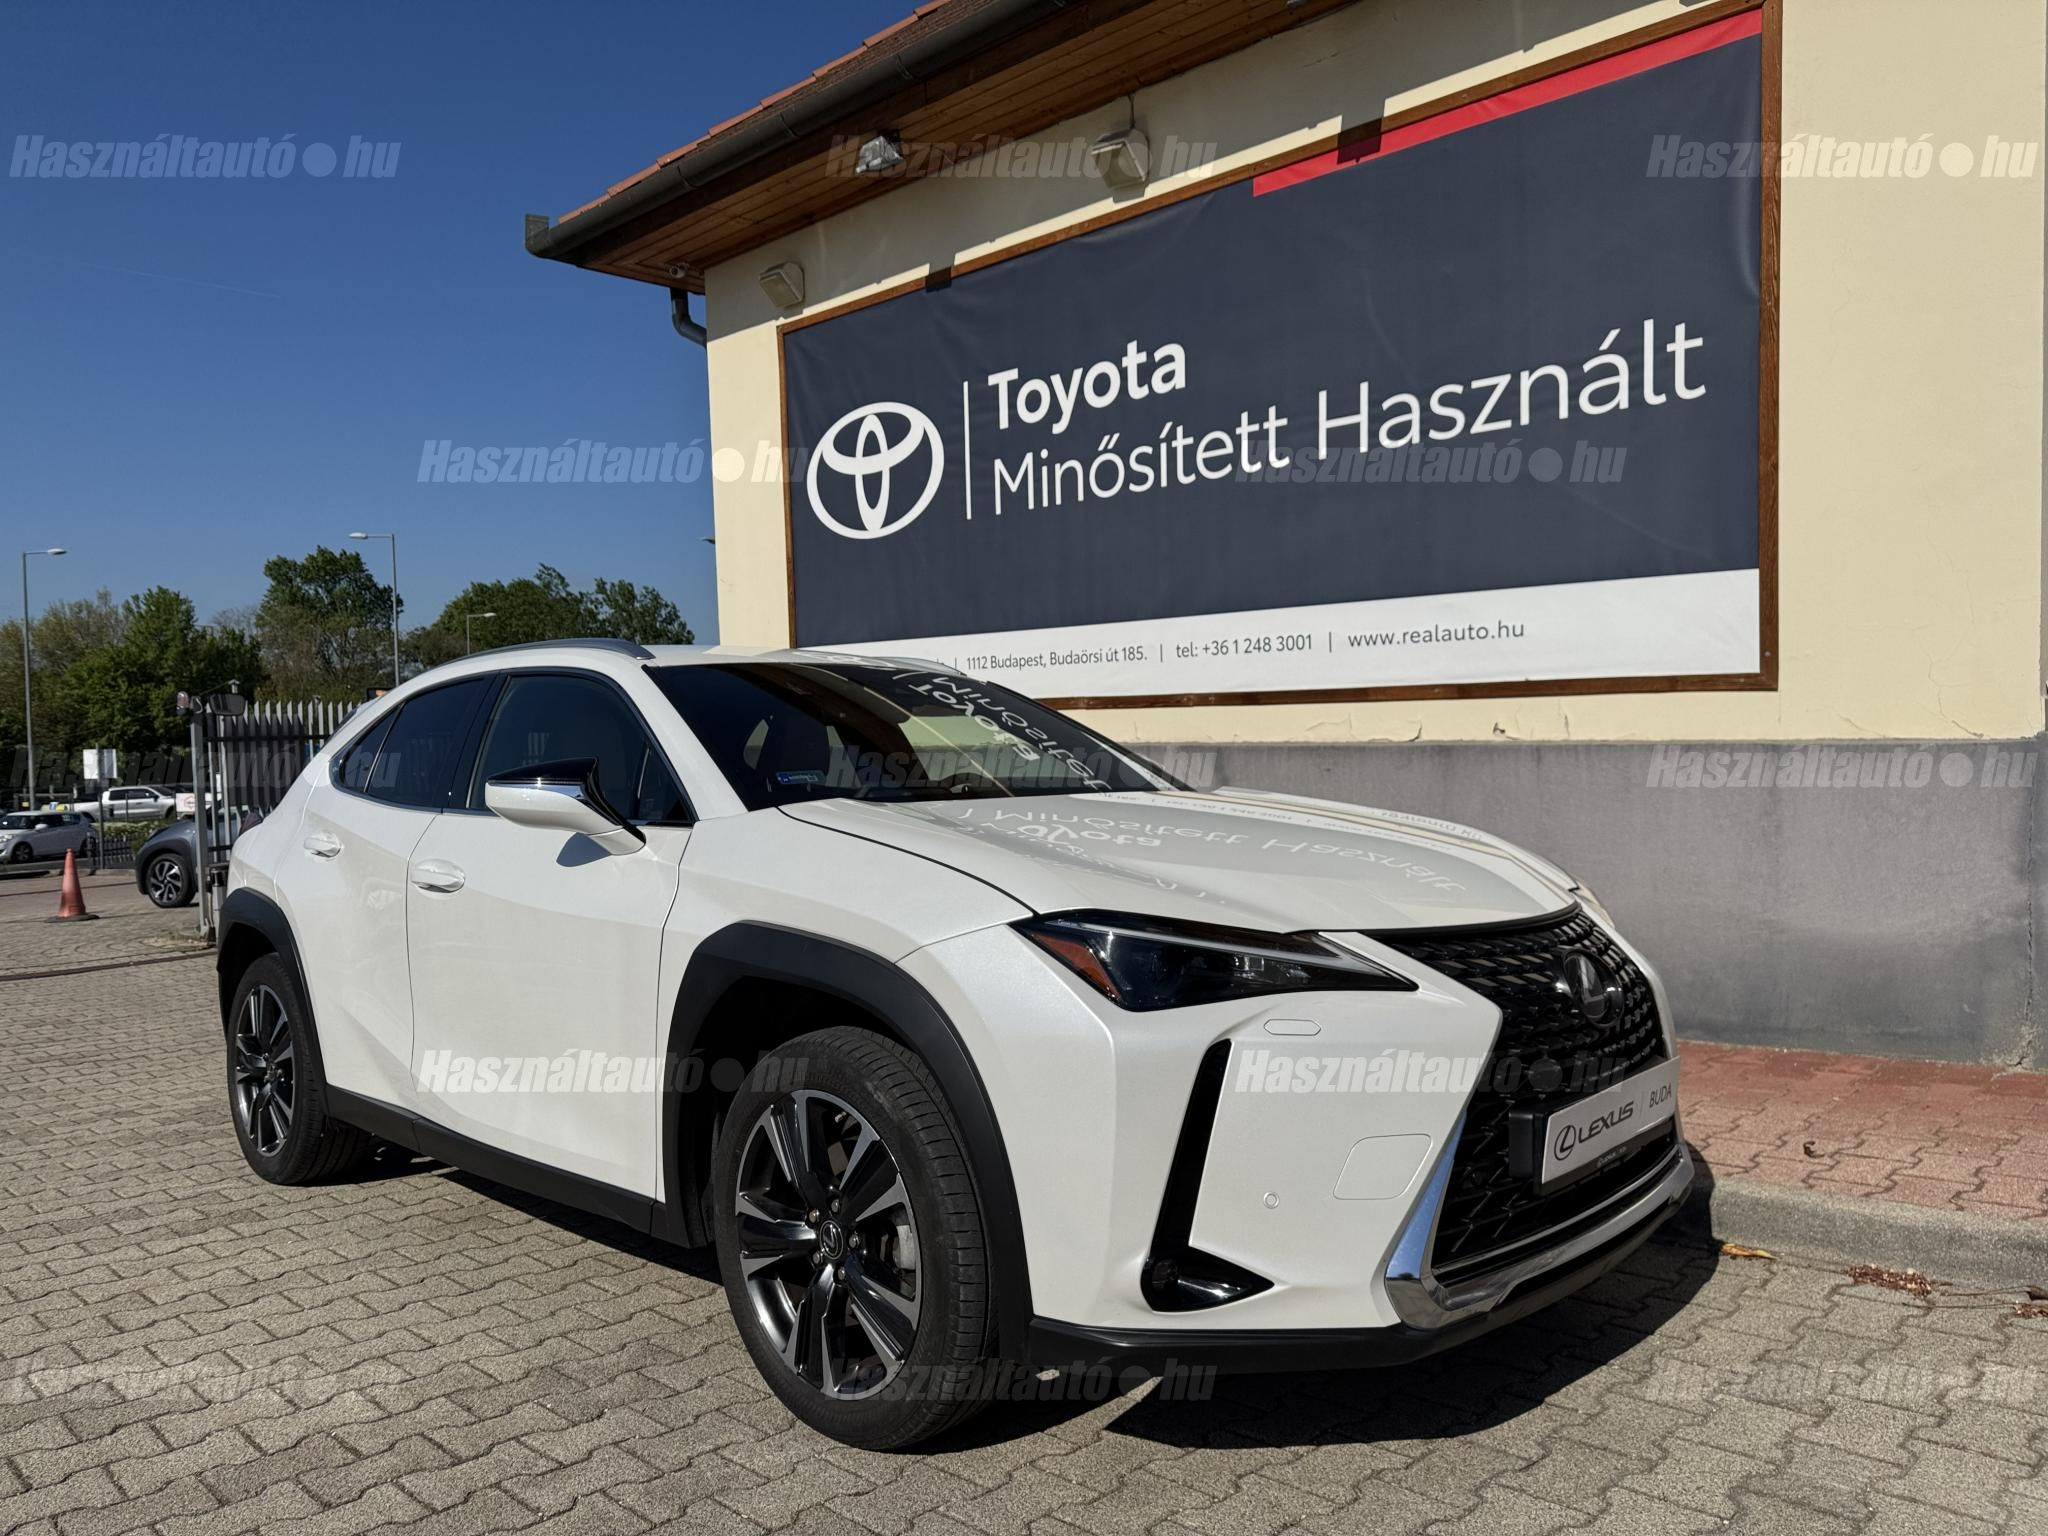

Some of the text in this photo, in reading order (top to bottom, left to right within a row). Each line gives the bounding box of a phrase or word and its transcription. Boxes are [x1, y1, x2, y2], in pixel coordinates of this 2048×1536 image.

[988, 340, 1186, 434] Toyota
[994, 318, 1706, 515] Minősített Használt
[1176, 642, 1198, 659] tel:
[1202, 639, 1229, 656] +36
[1244, 637, 1272, 653] 248
[1276, 634, 1313, 652] 3001
[1348, 620, 1525, 648] www.realauto.hu
[966, 645, 1148, 671] 1112 Budapest, Budaörsi út 185.
[1578, 1082, 1672, 1144] LEXUS BUDA
